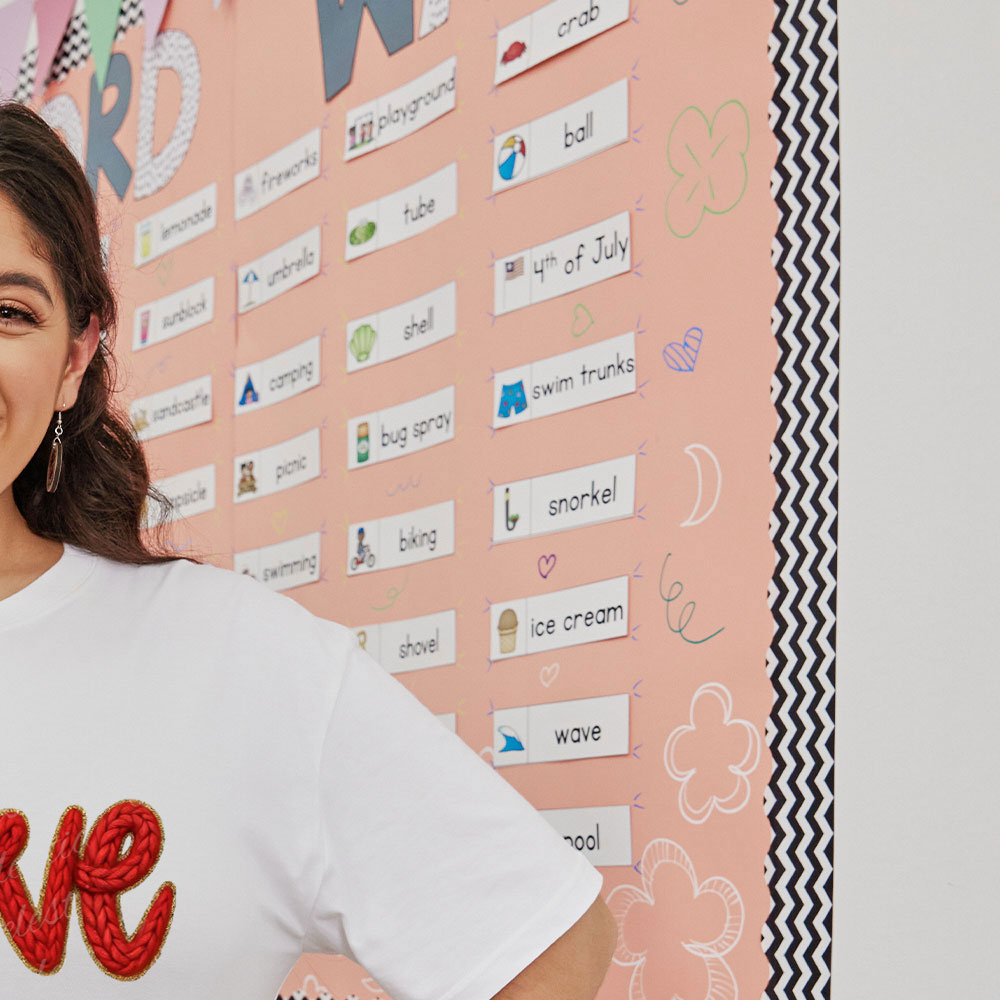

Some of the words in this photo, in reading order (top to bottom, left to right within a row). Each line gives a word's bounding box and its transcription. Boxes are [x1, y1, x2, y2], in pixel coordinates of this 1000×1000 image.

[556, 0, 600, 38] crab
[376, 64, 457, 136] playground
[564, 110, 594, 149] ball
[260, 146, 318, 196] fireworks
[160, 200, 213, 242] lemonade
[403, 194, 436, 226] tube
[267, 246, 315, 288] umbrella
[533, 250, 559, 284] 4th
[563, 243, 586, 276] of
[592, 230, 630, 265] July
[161, 292, 207, 330] sunblock
[403, 305, 435, 342] shell
[268, 360, 314, 393] camping
[531, 376, 575, 400] swim
[580, 352, 636, 387] trunks
[152, 385, 210, 423] sandcastle
[381, 422, 408, 448] bug
[412, 410, 453, 442] spray
[275, 454, 308, 485] picnic
[548, 474, 617, 517] snorkel
[399, 525, 438, 552] biking
[262, 555, 318, 583] swimming
[531, 617, 556, 638] ice
[563, 604, 624, 632] cream
[399, 627, 440, 659] shovel
[554, 724, 602, 745] wave
